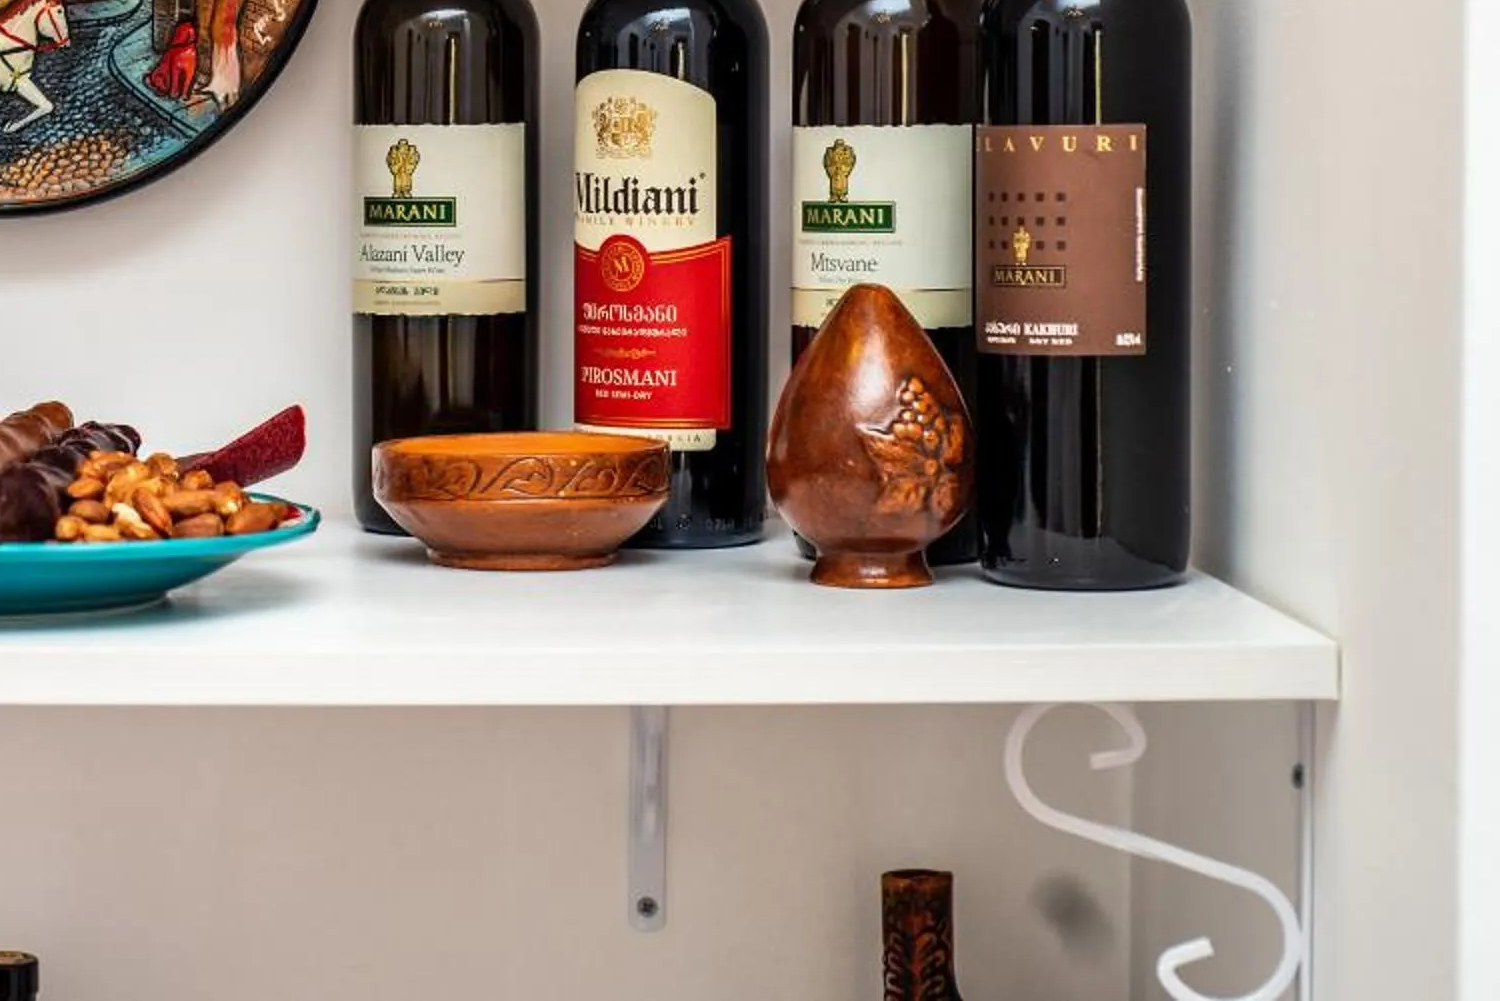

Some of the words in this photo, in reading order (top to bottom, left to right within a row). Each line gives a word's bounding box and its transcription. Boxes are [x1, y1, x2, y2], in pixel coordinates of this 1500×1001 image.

[976, 134, 1138, 153] LAVURI
[369, 204, 446, 222] MARANI
[806, 208, 884, 226] MARANI
[360, 243, 407, 263] Alazani
[411, 243, 465, 267] Valley
[811, 251, 879, 273] Mtsvane
[995, 268, 1056, 286] MARANI
